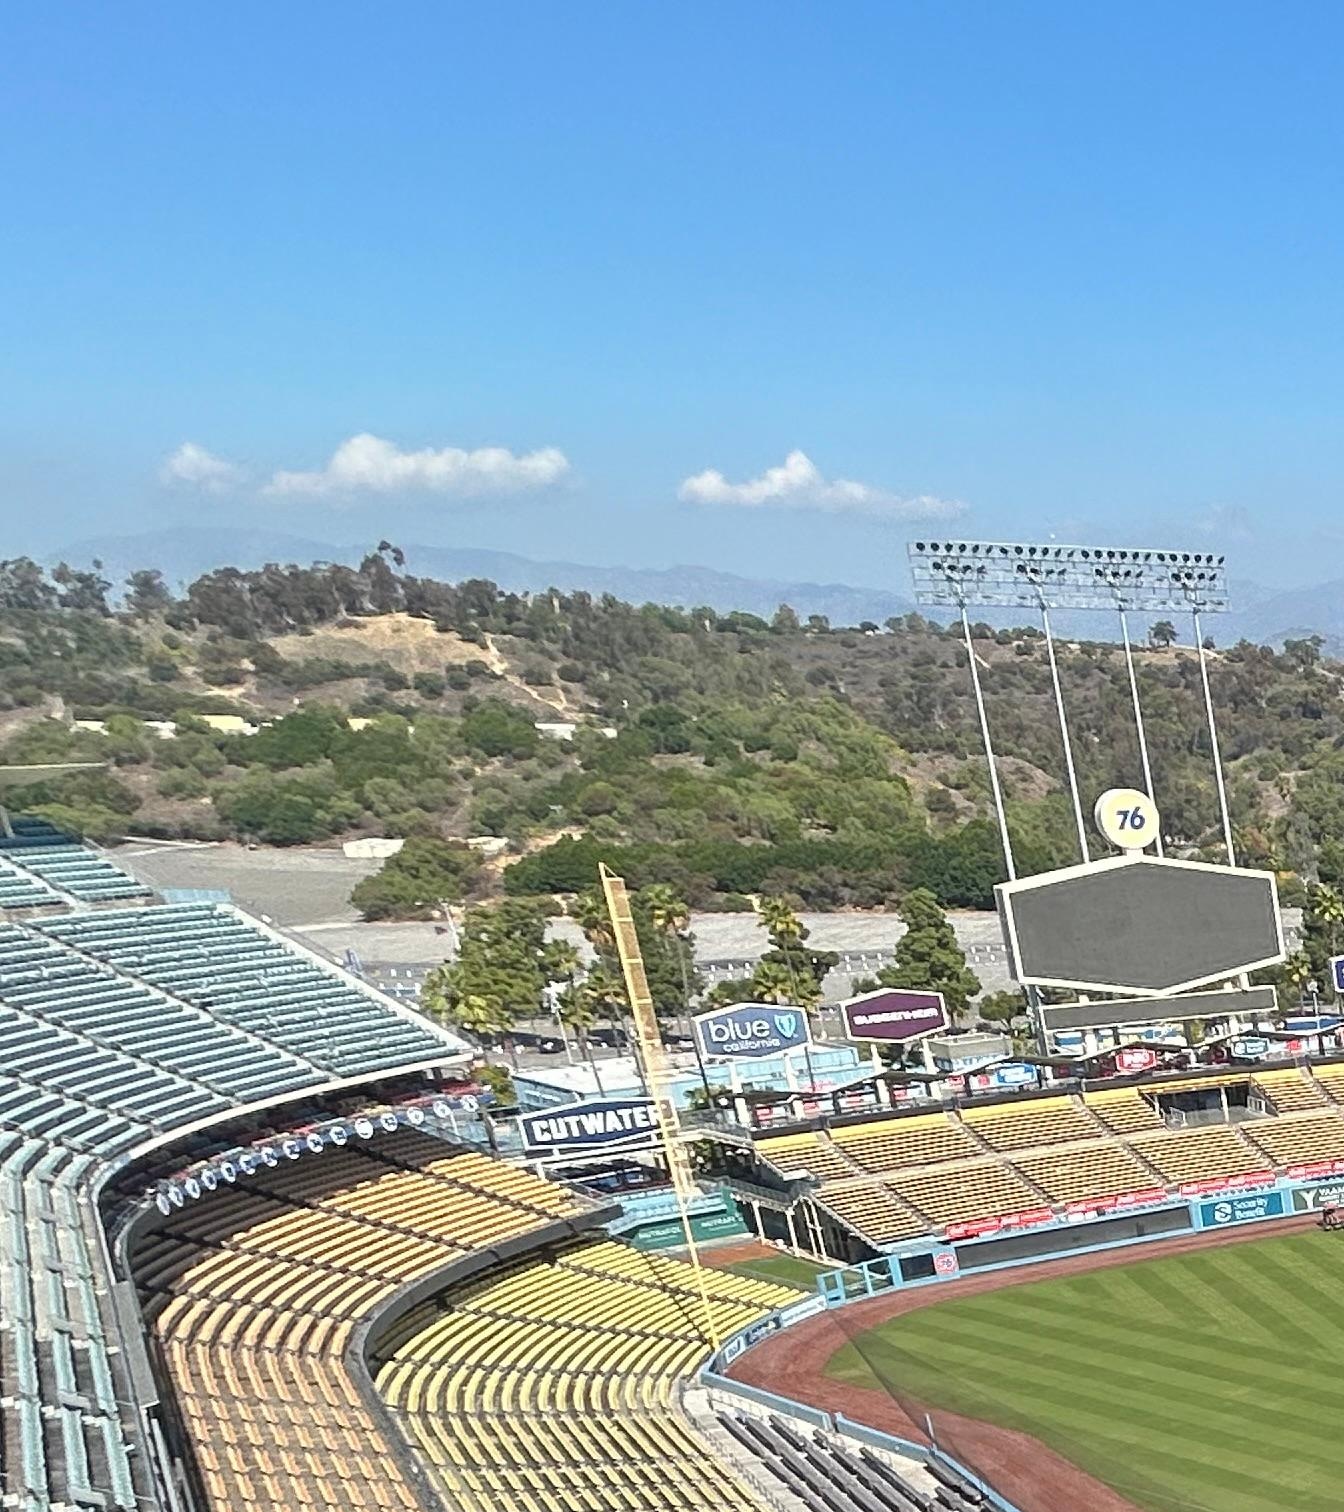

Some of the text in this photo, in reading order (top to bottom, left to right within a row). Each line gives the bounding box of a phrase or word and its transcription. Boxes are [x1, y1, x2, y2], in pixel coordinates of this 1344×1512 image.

[1116, 806, 1146, 830] 76
[708, 1017, 770, 1042] blue
[723, 1038, 780, 1053] california
[1233, 1198, 1268, 1210] Security
